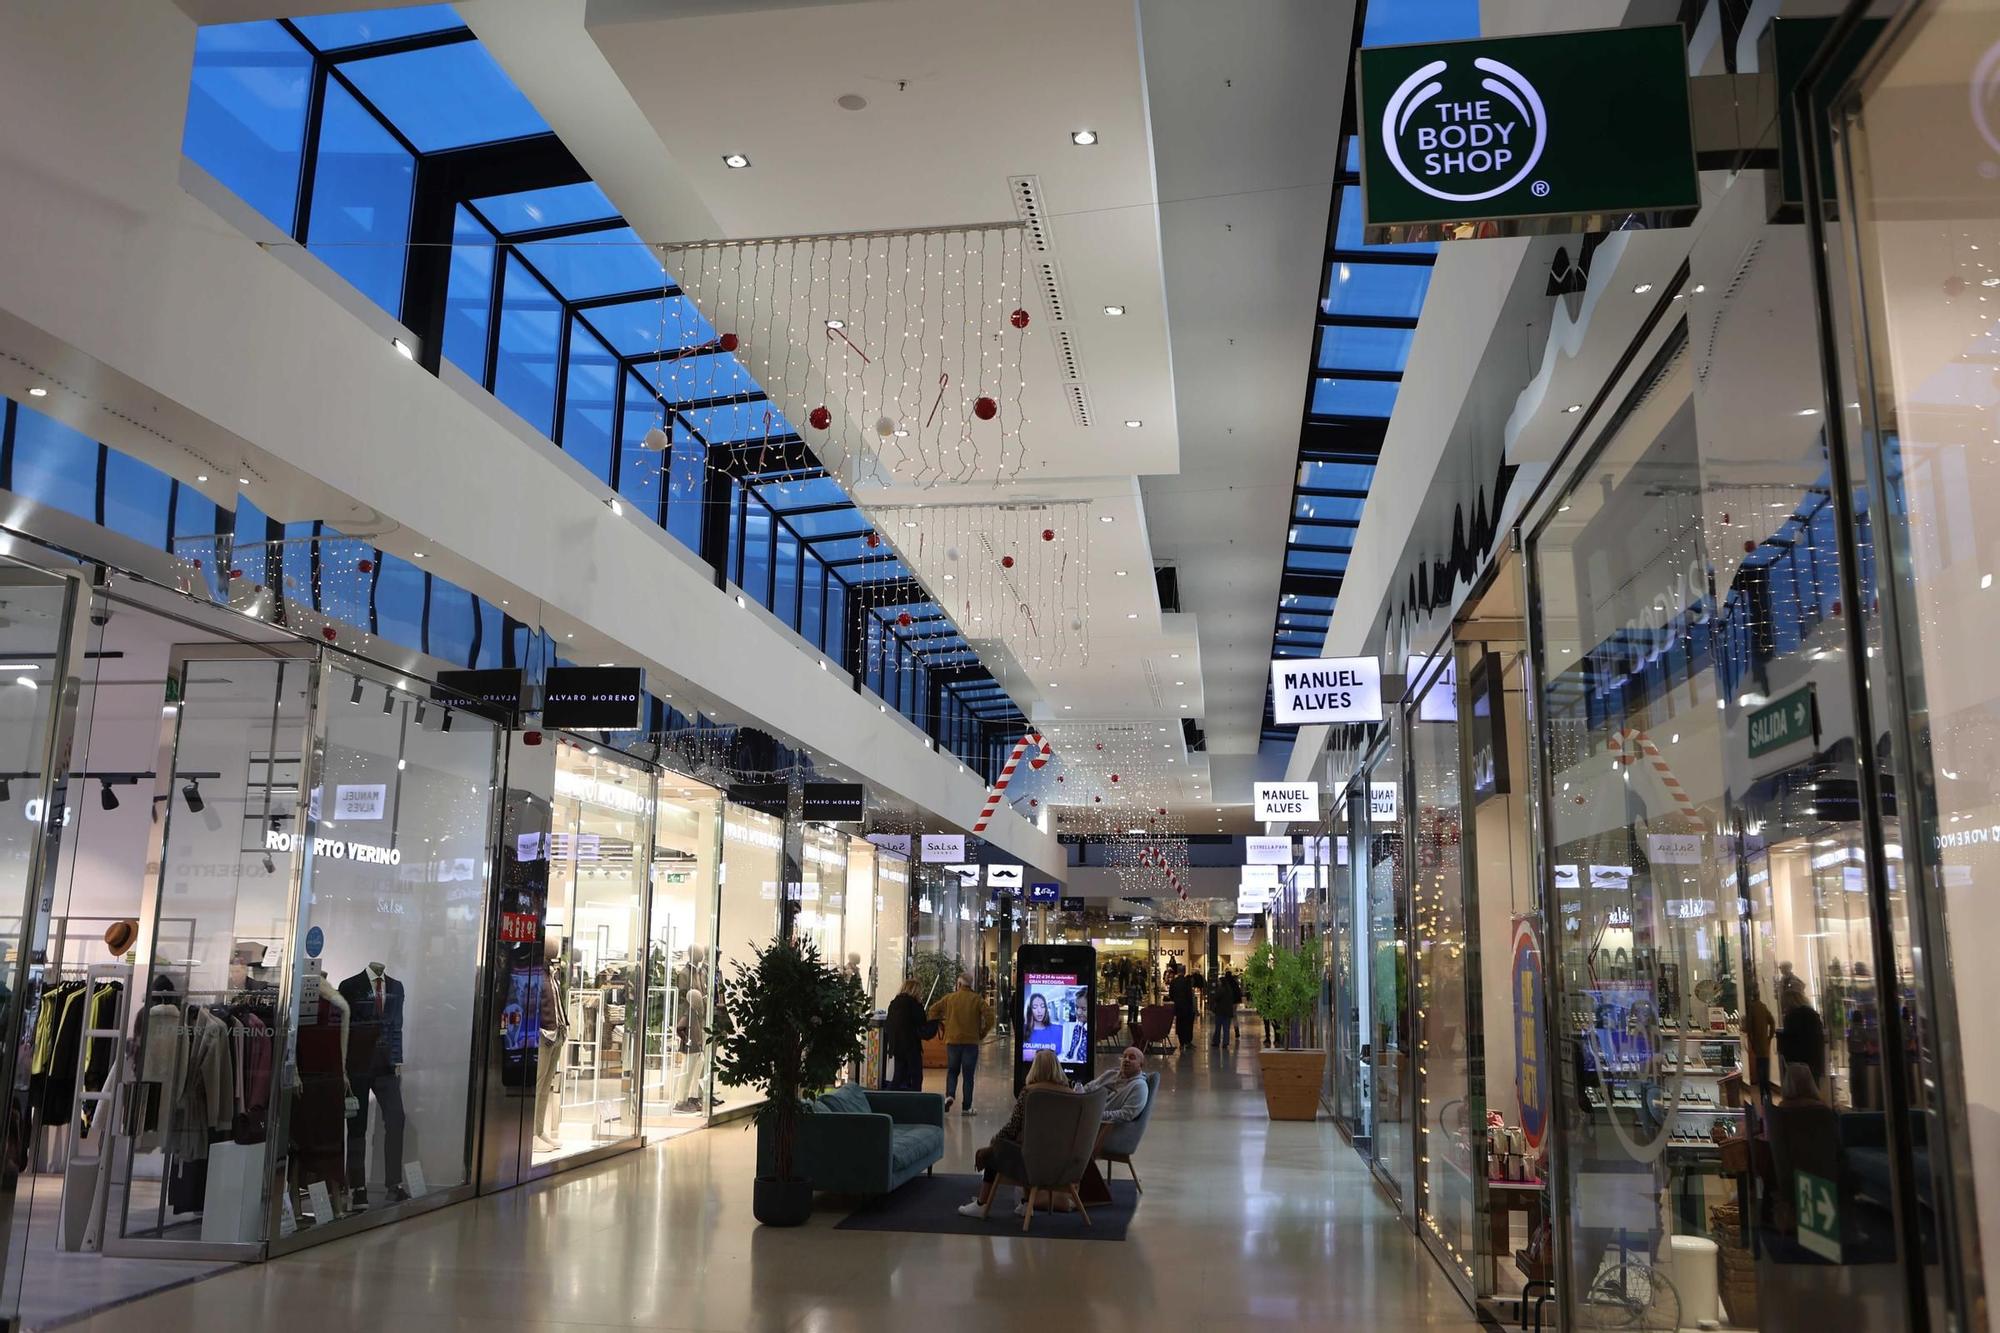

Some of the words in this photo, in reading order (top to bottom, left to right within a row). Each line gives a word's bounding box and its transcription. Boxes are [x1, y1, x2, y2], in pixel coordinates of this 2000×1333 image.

[1435, 100, 1492, 122] THE
[1418, 122, 1516, 150] BODY
[1424, 149, 1513, 175] SHOP
[1285, 670, 1363, 689] MANUEL
[1292, 692, 1351, 711] ALVES
[1751, 708, 1788, 748] SALIDA
[1262, 790, 1309, 800] MANUEL
[1266, 803, 1302, 813] ALVES
[265, 830, 345, 860] RORTO
[347, 841, 401, 866] VERINO
